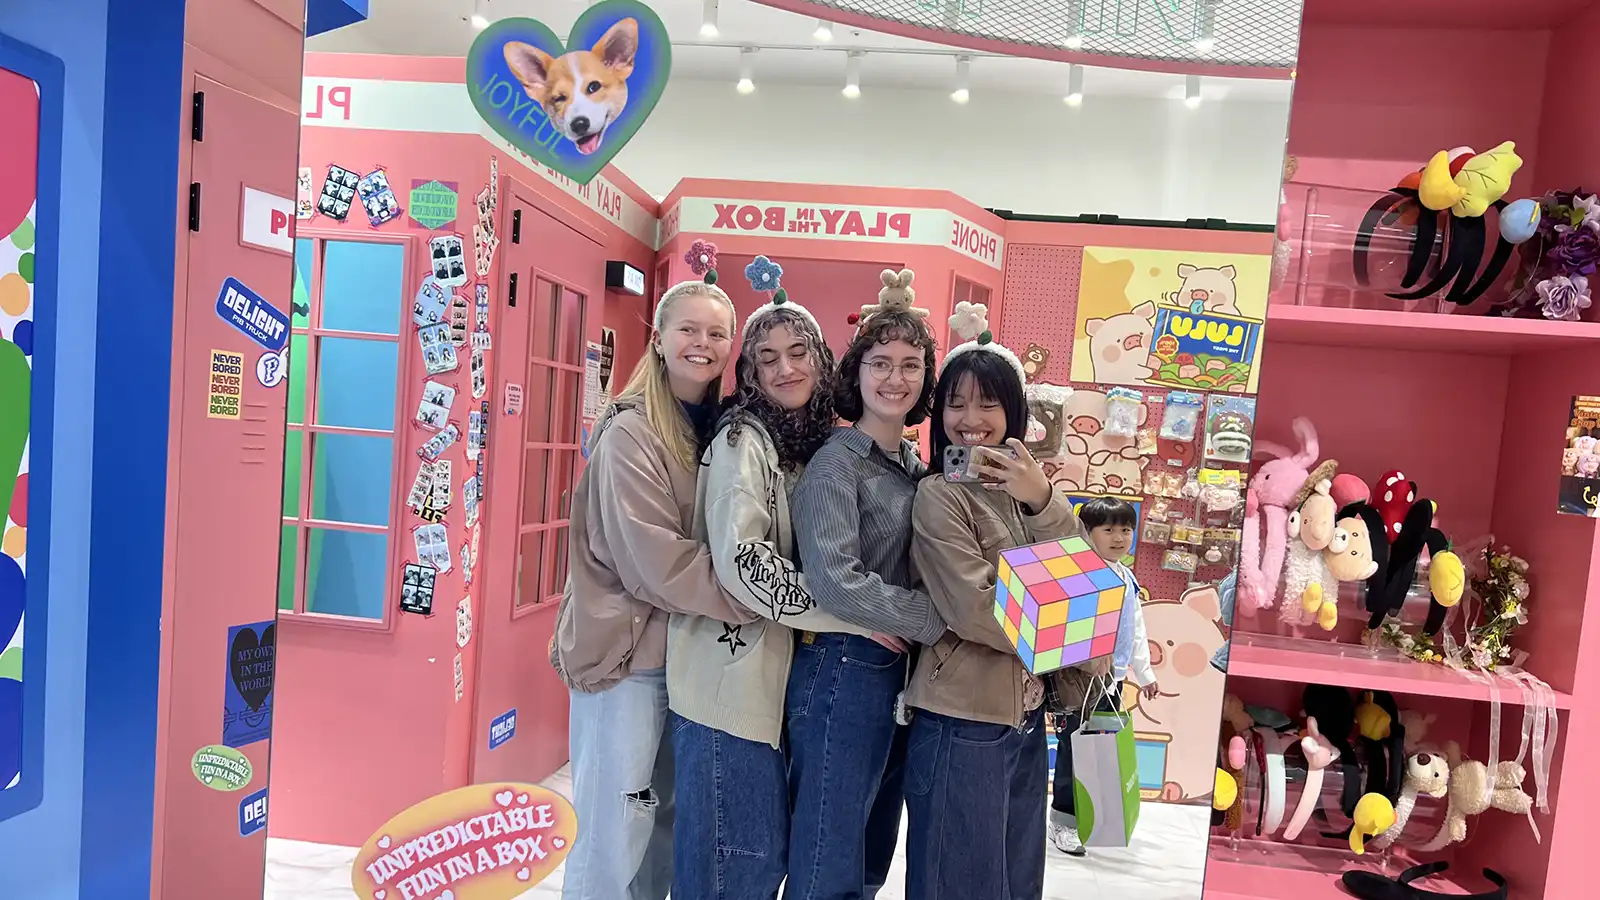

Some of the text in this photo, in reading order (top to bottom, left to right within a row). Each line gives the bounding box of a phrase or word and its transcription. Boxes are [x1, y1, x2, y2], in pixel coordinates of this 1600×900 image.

[475, 73, 561, 159] JOYFUL
[223, 286, 285, 341] DELIGHT
[232, 314, 268, 342] PIB TRUCK
[213, 353, 241, 366] NEVER
[212, 363, 241, 375] BORED
[264, 357, 280, 383] P
[211, 374, 240, 386] NEVER
[210, 384, 240, 395] BORED
[210, 395, 239, 407] NEVER
[209, 405, 239, 416] BORED
[238, 649, 254, 661] MY
[241, 660, 273, 677] IN THE
[199, 754, 248, 777] UNPREDICTABLE
[201, 765, 215, 775] FUN
[215, 767, 224, 777] IN
[227, 771, 241, 785] BOX
[366, 803, 555, 885] UNPREDICTABLE
[396, 835, 548, 900] FUN IN A BOX
